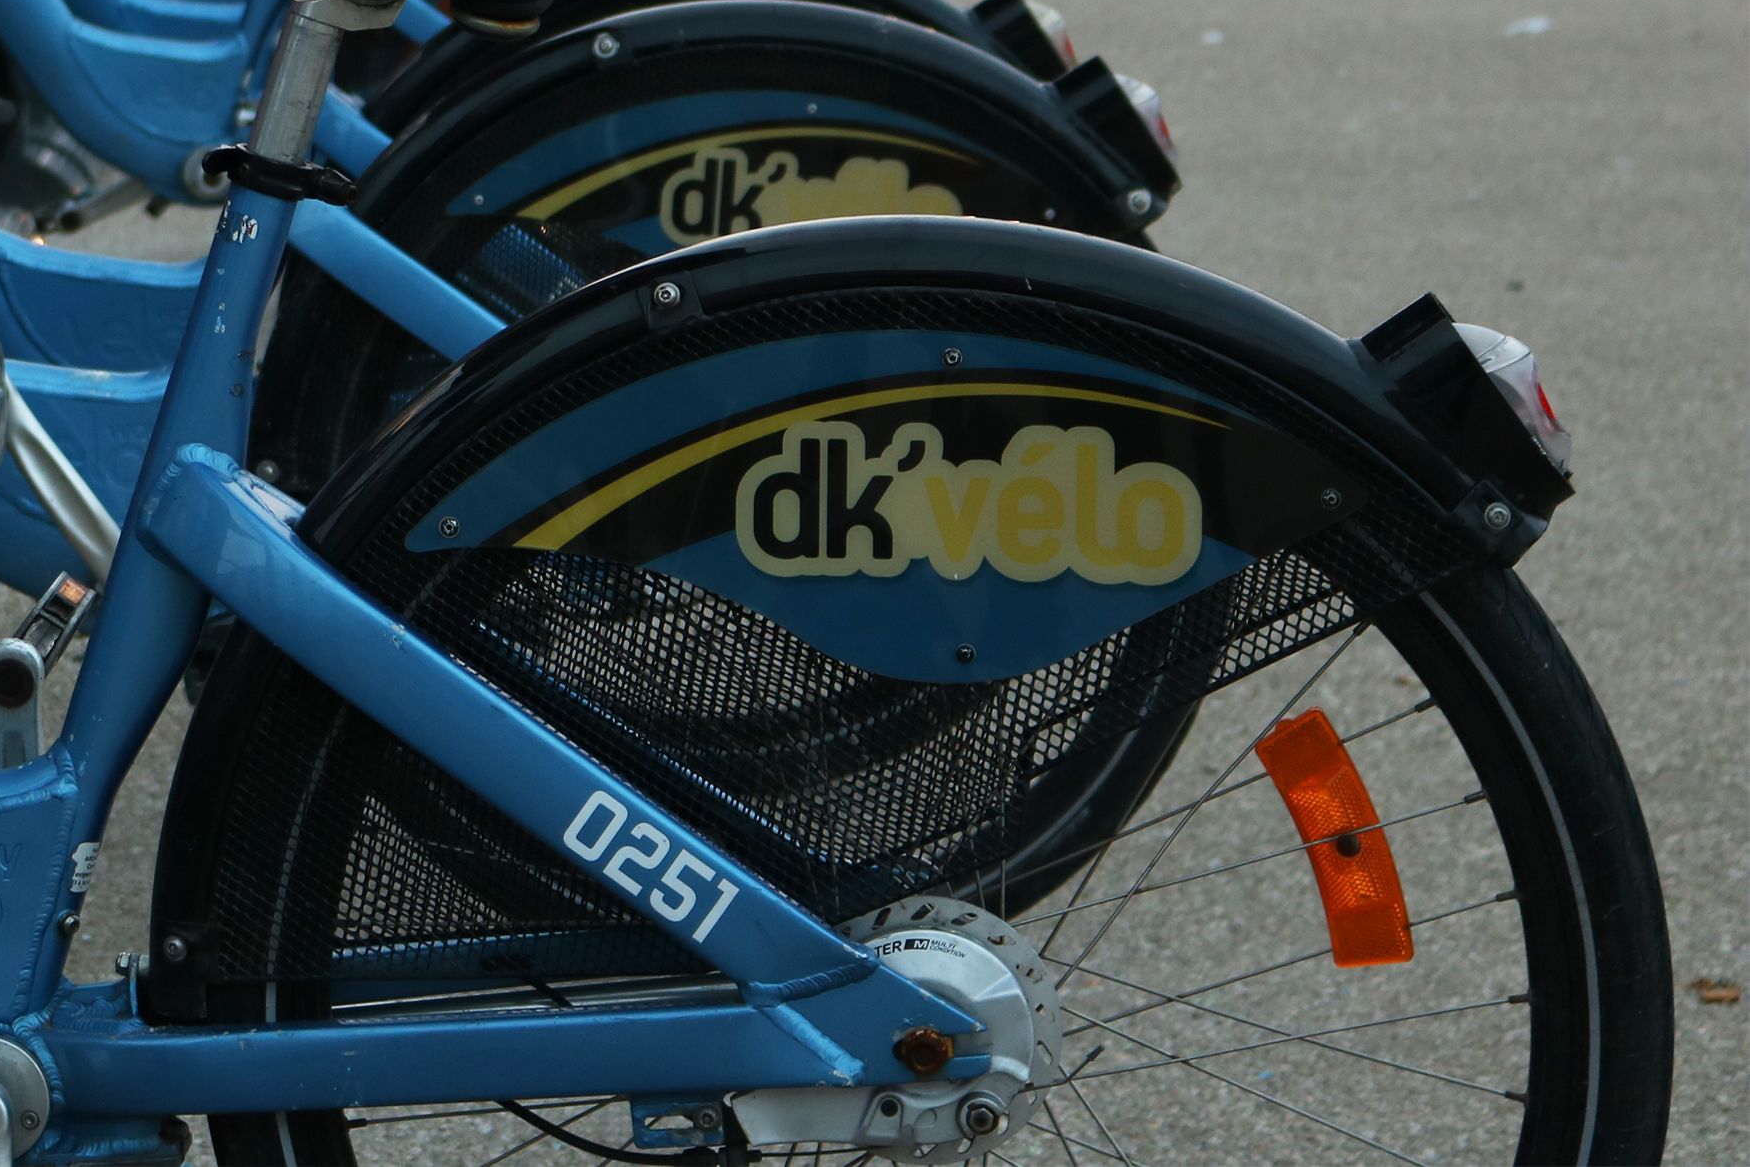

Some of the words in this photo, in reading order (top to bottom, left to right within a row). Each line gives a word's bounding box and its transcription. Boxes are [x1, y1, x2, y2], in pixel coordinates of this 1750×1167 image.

[753, 437, 1185, 568] dk'vélo
[563, 790, 740, 944] 0251
[873, 941, 903, 958] TER
